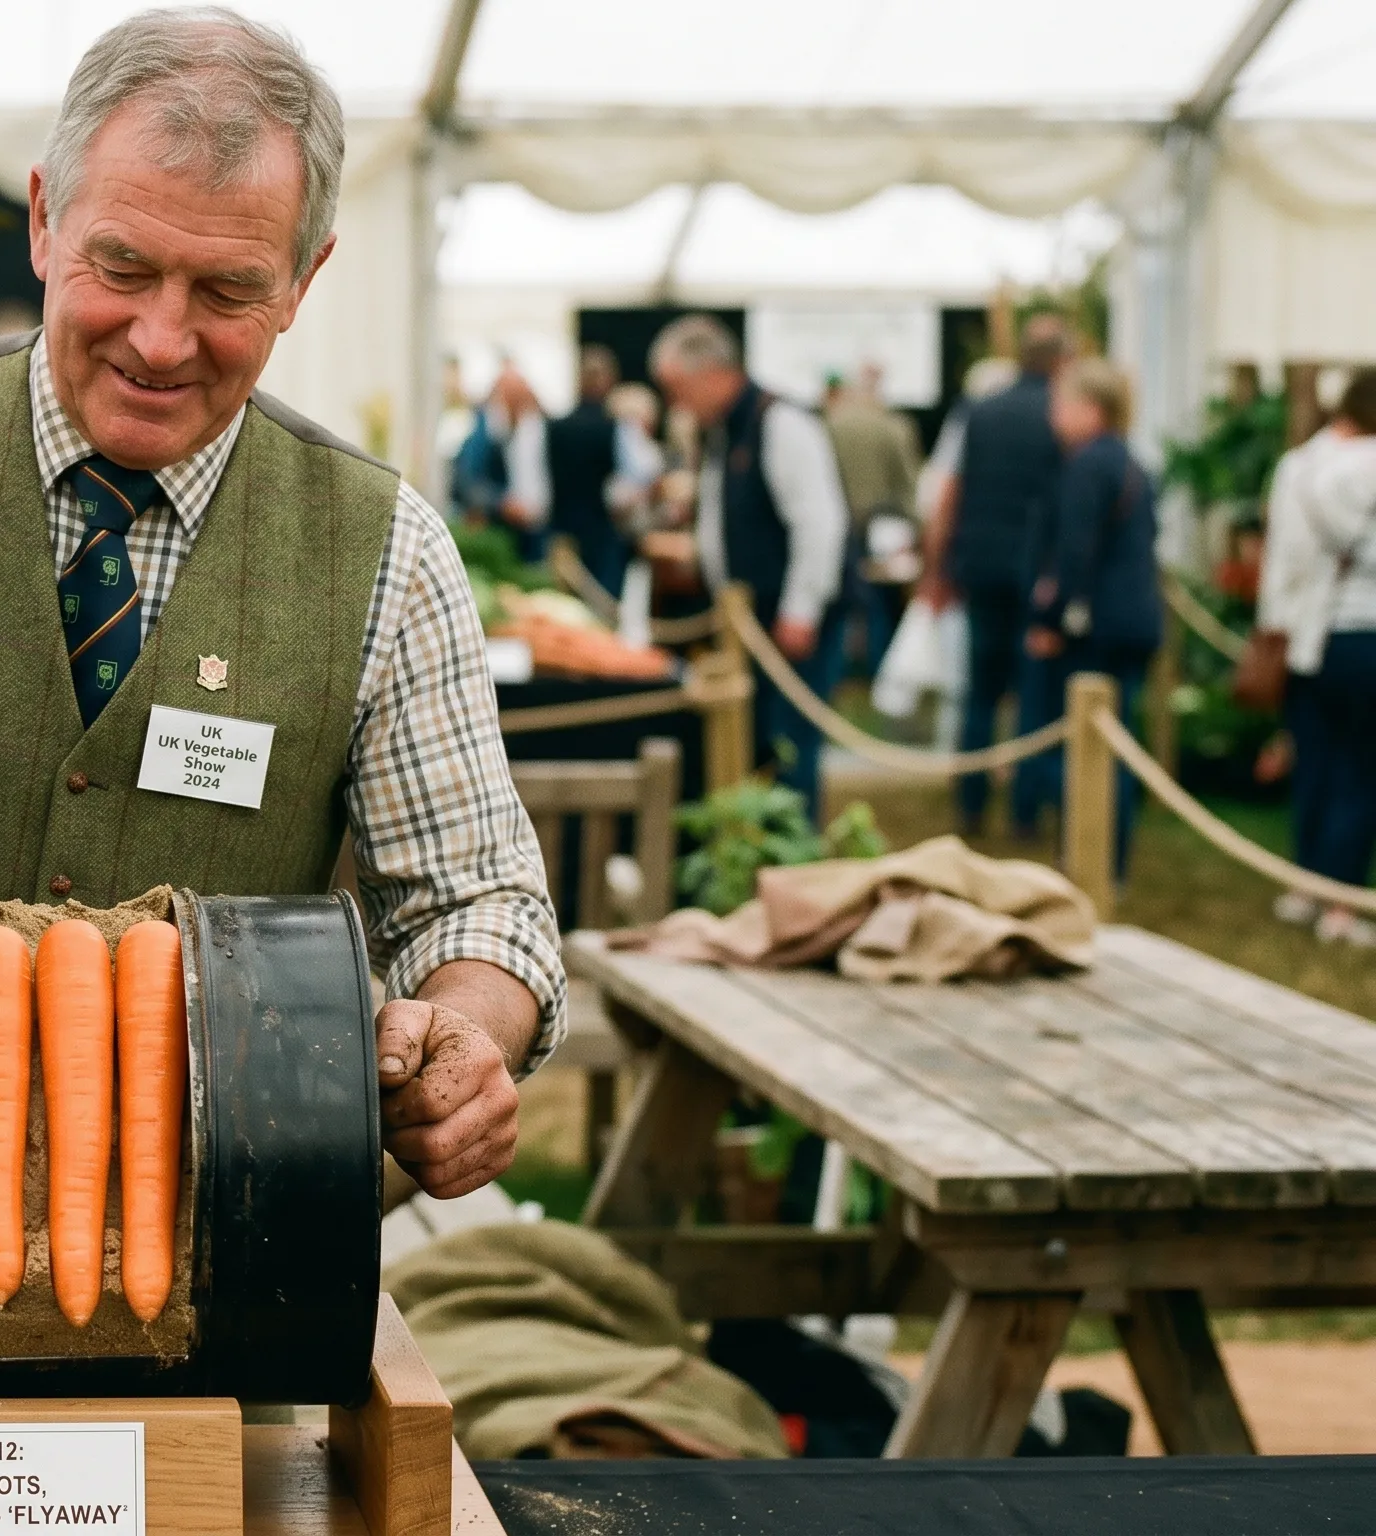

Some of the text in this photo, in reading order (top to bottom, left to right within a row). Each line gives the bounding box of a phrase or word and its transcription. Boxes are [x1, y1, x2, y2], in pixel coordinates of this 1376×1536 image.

[201, 725, 223, 740] UK
[158, 735, 258, 763] UK Vegetable
[184, 756, 226, 774] Show
[183, 773, 220, 790] 2024
